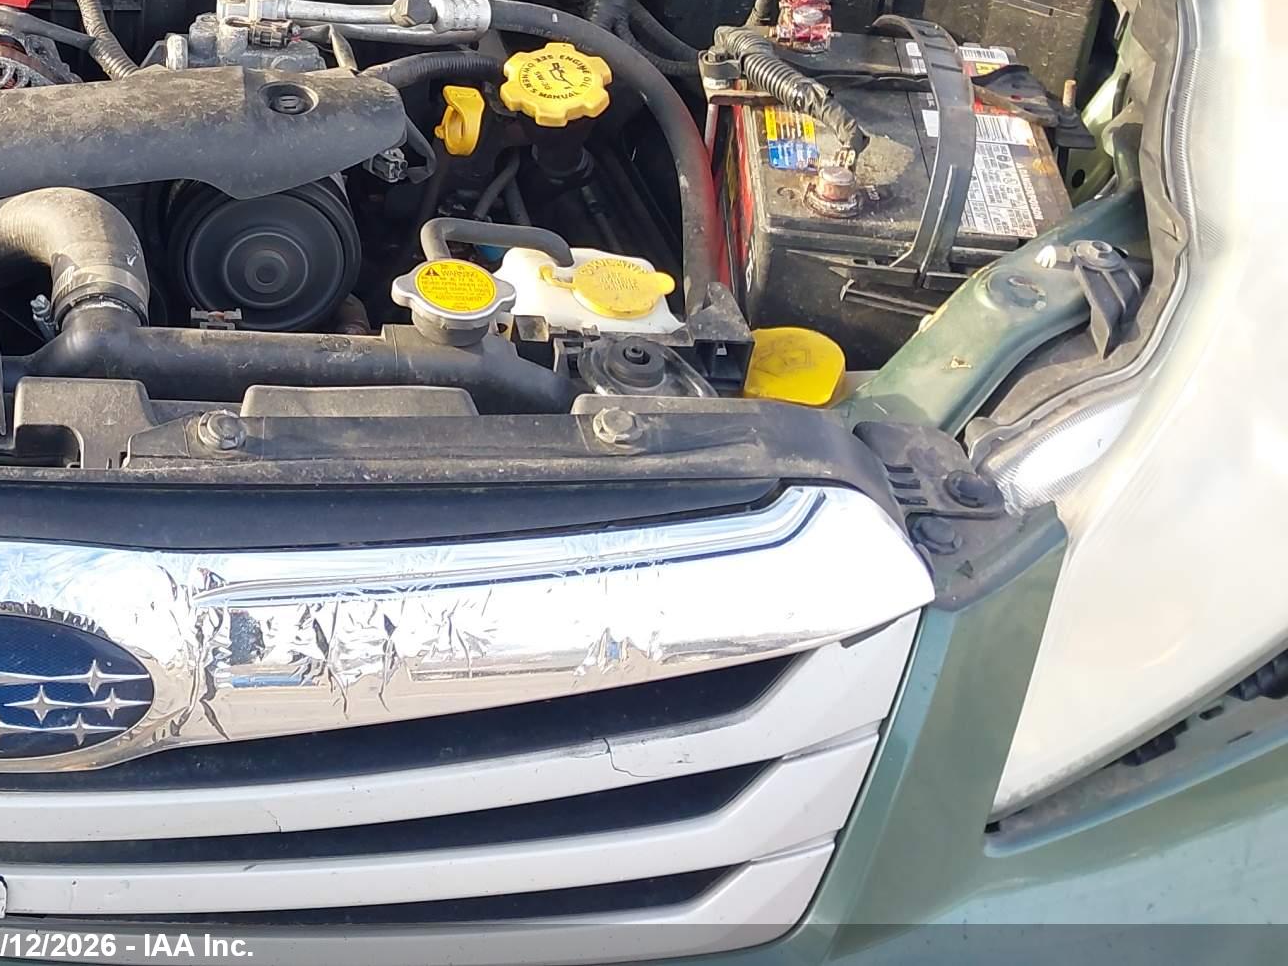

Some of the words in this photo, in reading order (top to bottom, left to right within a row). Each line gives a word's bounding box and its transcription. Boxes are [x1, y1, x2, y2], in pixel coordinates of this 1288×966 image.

[559, 55, 592, 74] ENGINE
[579, 76, 592, 88] OIL
[538, 91, 582, 100] MANUAL
